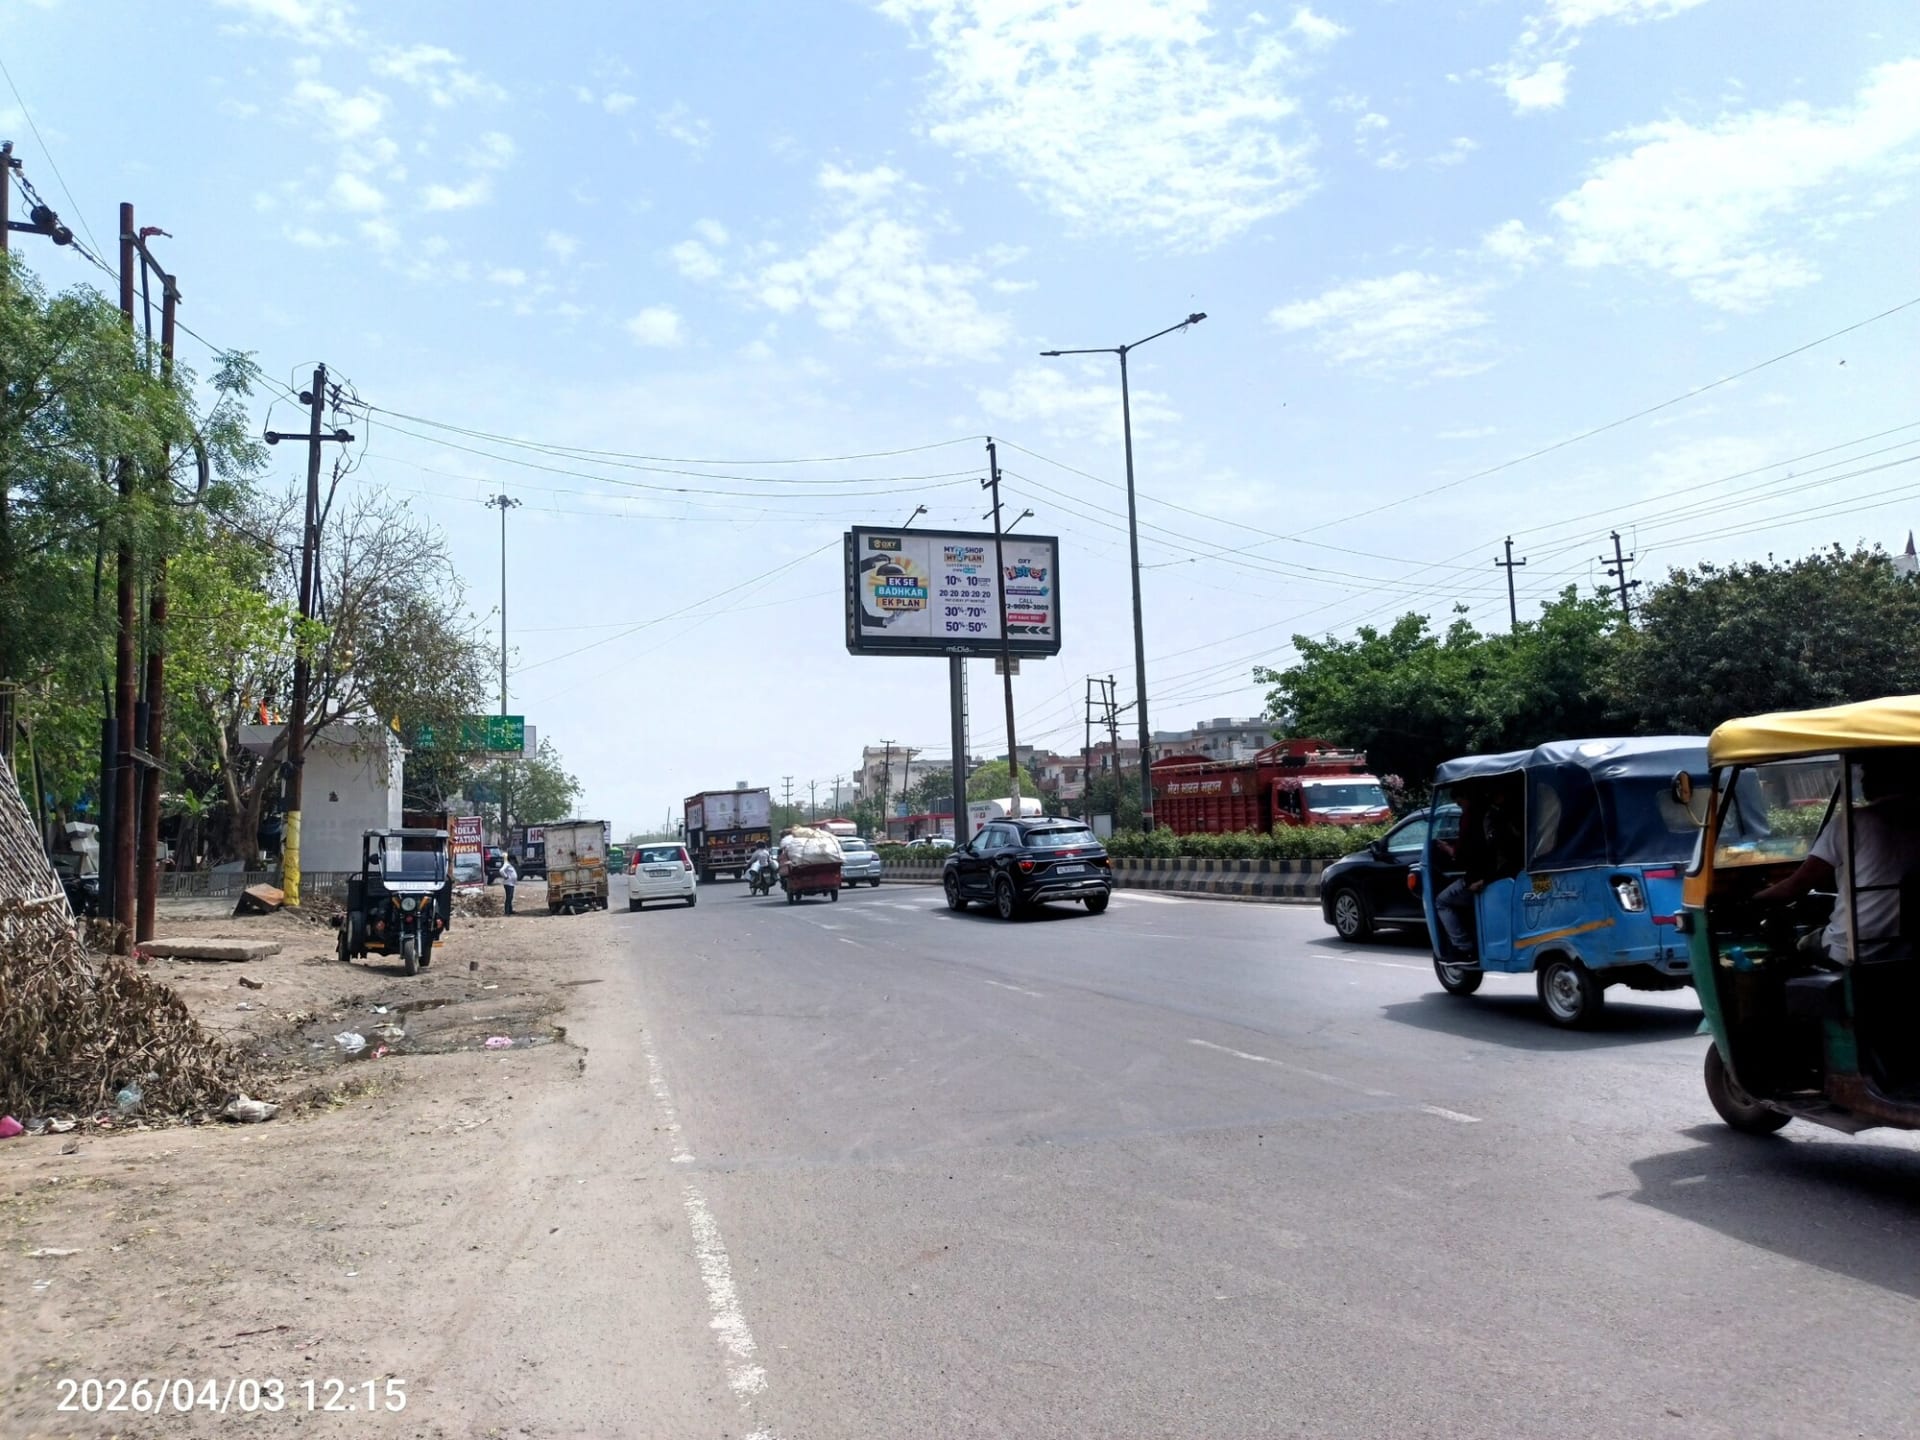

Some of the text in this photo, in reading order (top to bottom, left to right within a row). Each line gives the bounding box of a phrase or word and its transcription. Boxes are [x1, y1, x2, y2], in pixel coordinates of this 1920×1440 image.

[889, 578, 901, 586] EK
[967, 576, 978, 586] 10
[879, 587, 923, 597] BADHKAR
[896, 599, 920, 607] PLAN
